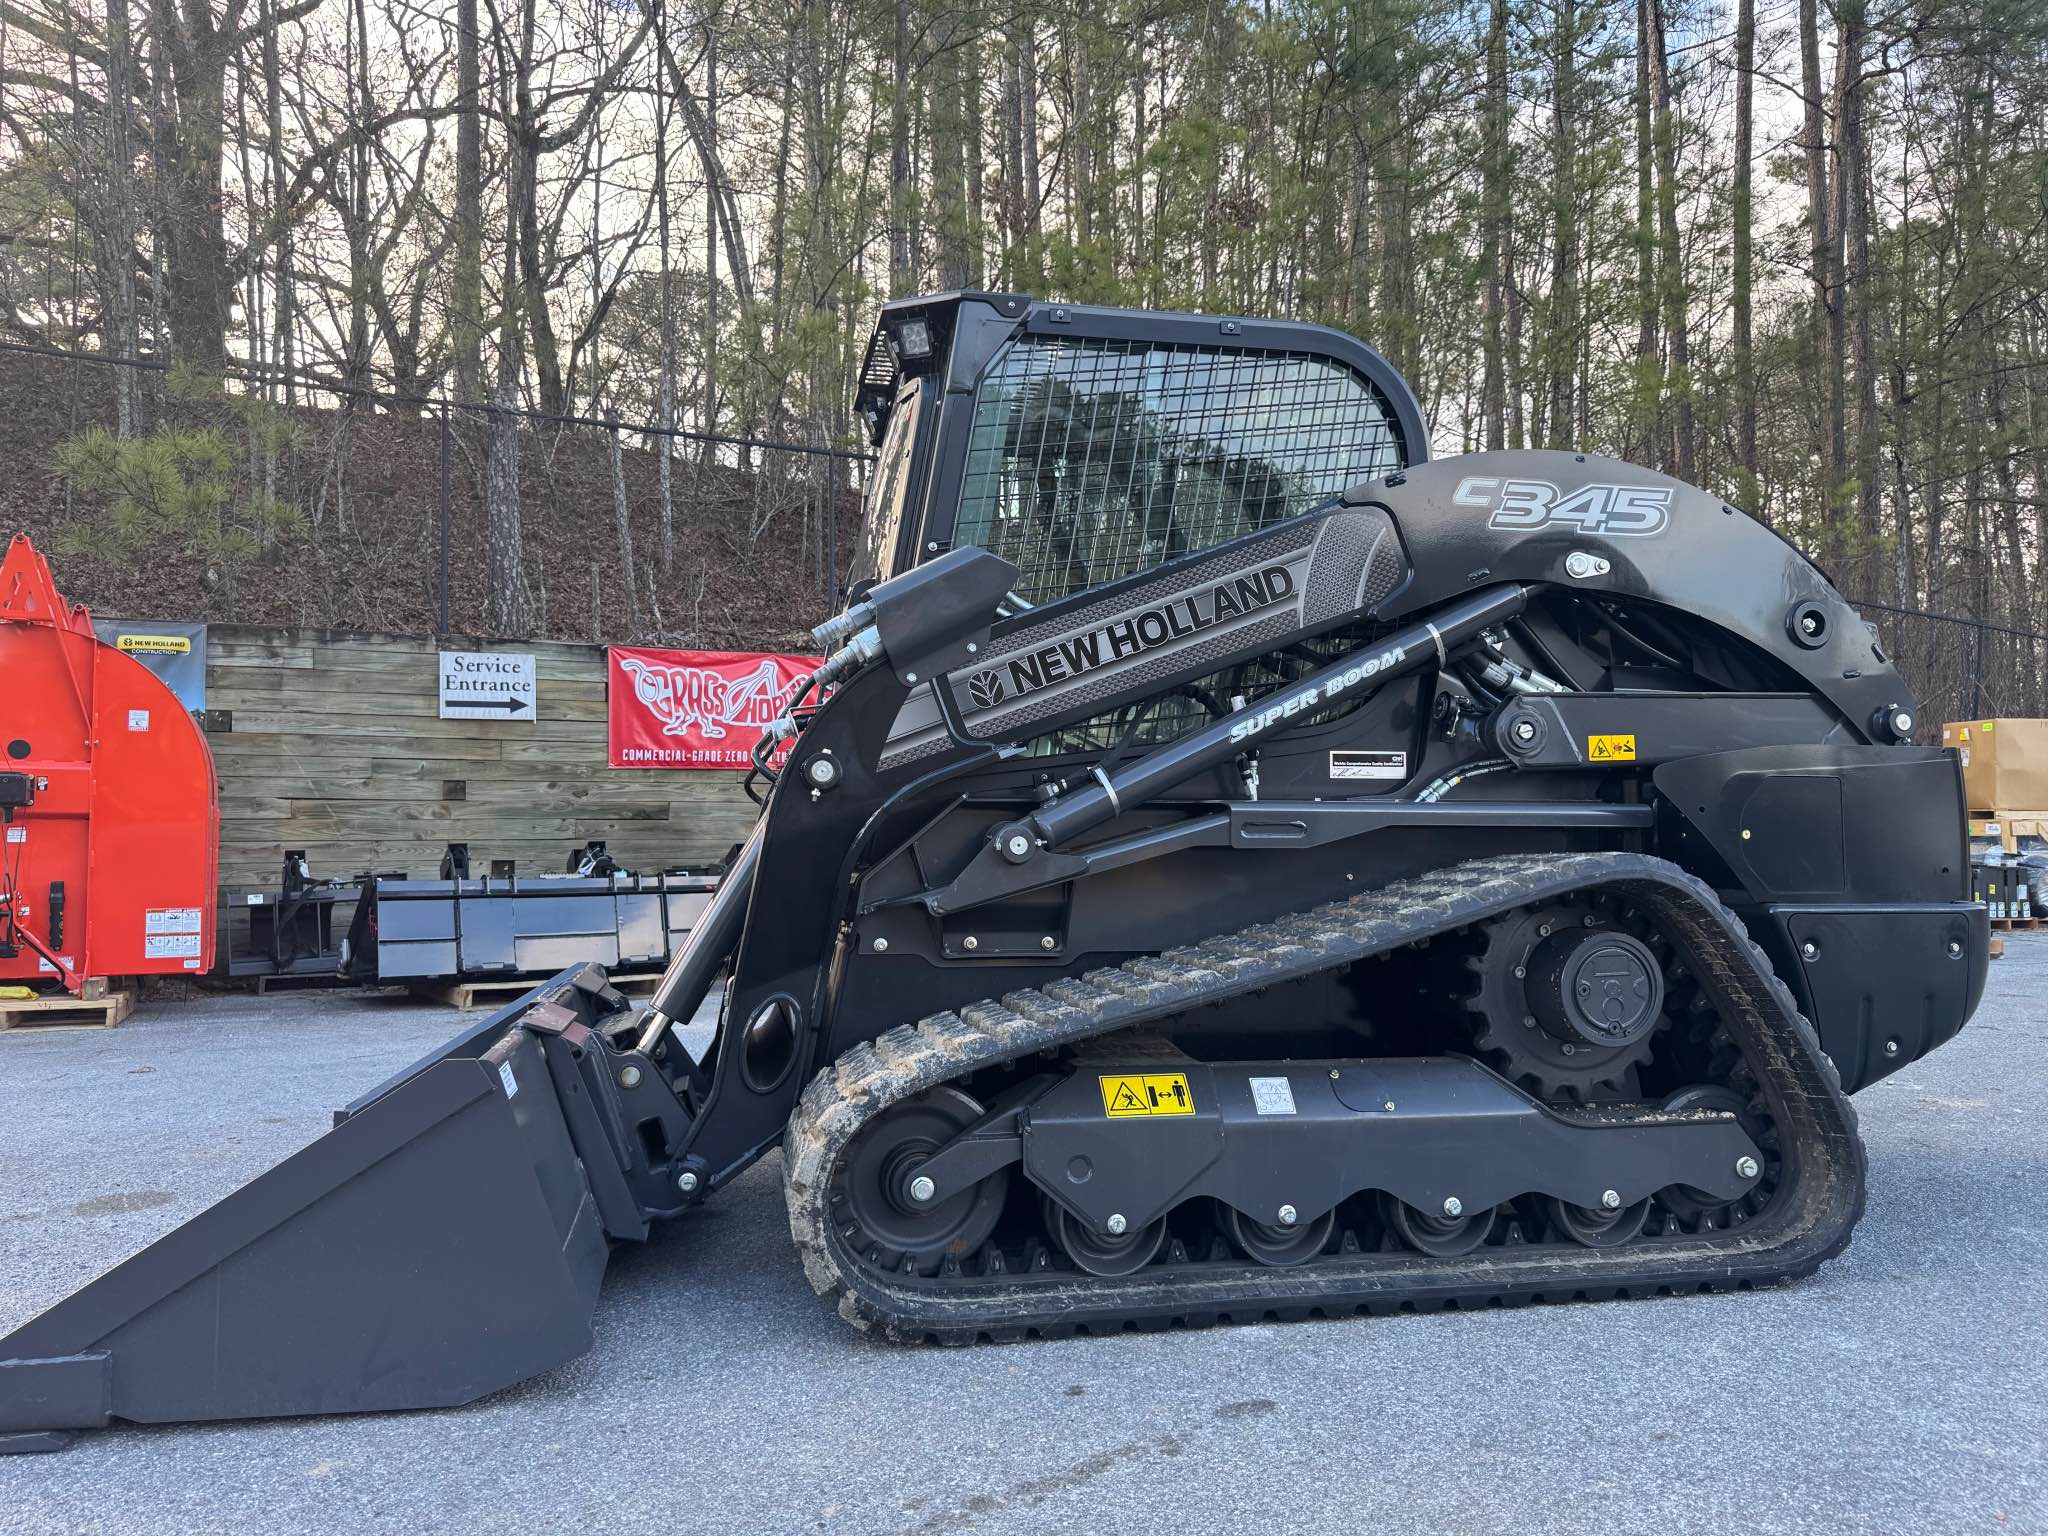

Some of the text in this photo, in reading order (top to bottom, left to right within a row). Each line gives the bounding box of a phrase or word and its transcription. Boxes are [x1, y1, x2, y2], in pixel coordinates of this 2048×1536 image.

[1007, 565, 1295, 696] NEW HOLLAND
[453, 655, 521, 673] Service
[445, 674, 531, 692] Entrance
[1228, 646, 1406, 744] SUPER BOOM
[622, 749, 722, 762] COMMERCIAL-GRADE
[725, 750, 749, 762] ZERO
